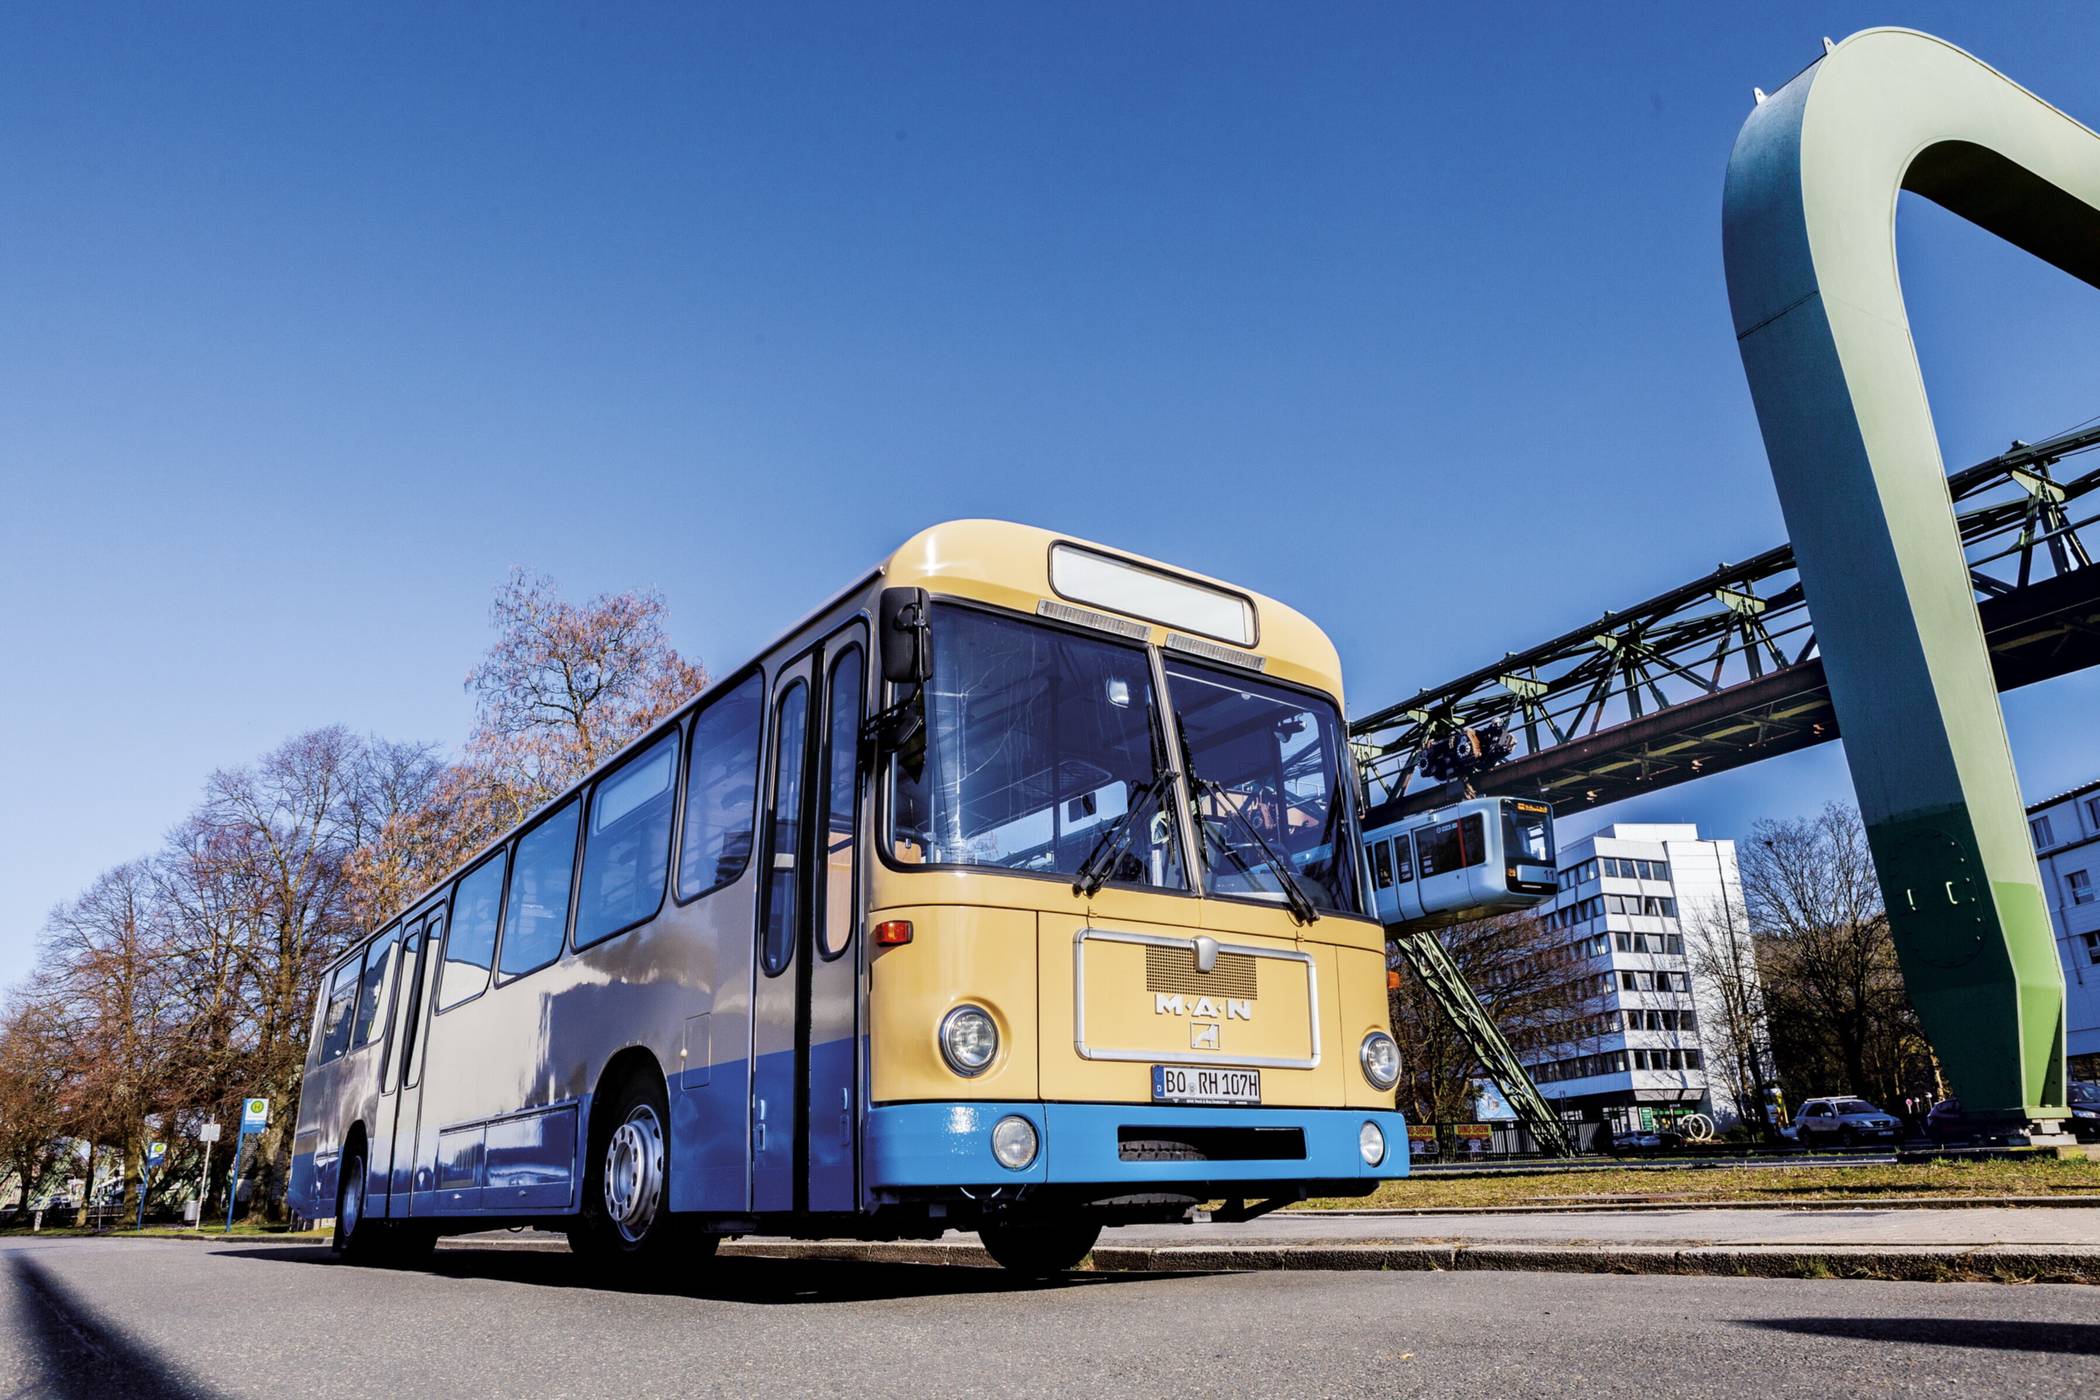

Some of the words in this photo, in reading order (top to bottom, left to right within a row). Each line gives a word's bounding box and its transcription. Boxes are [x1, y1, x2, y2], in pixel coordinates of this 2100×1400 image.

[1166, 1071, 1186, 1093] BO
[1198, 1072, 1218, 1094] RH
[1222, 1073, 1258, 1097] 107H
